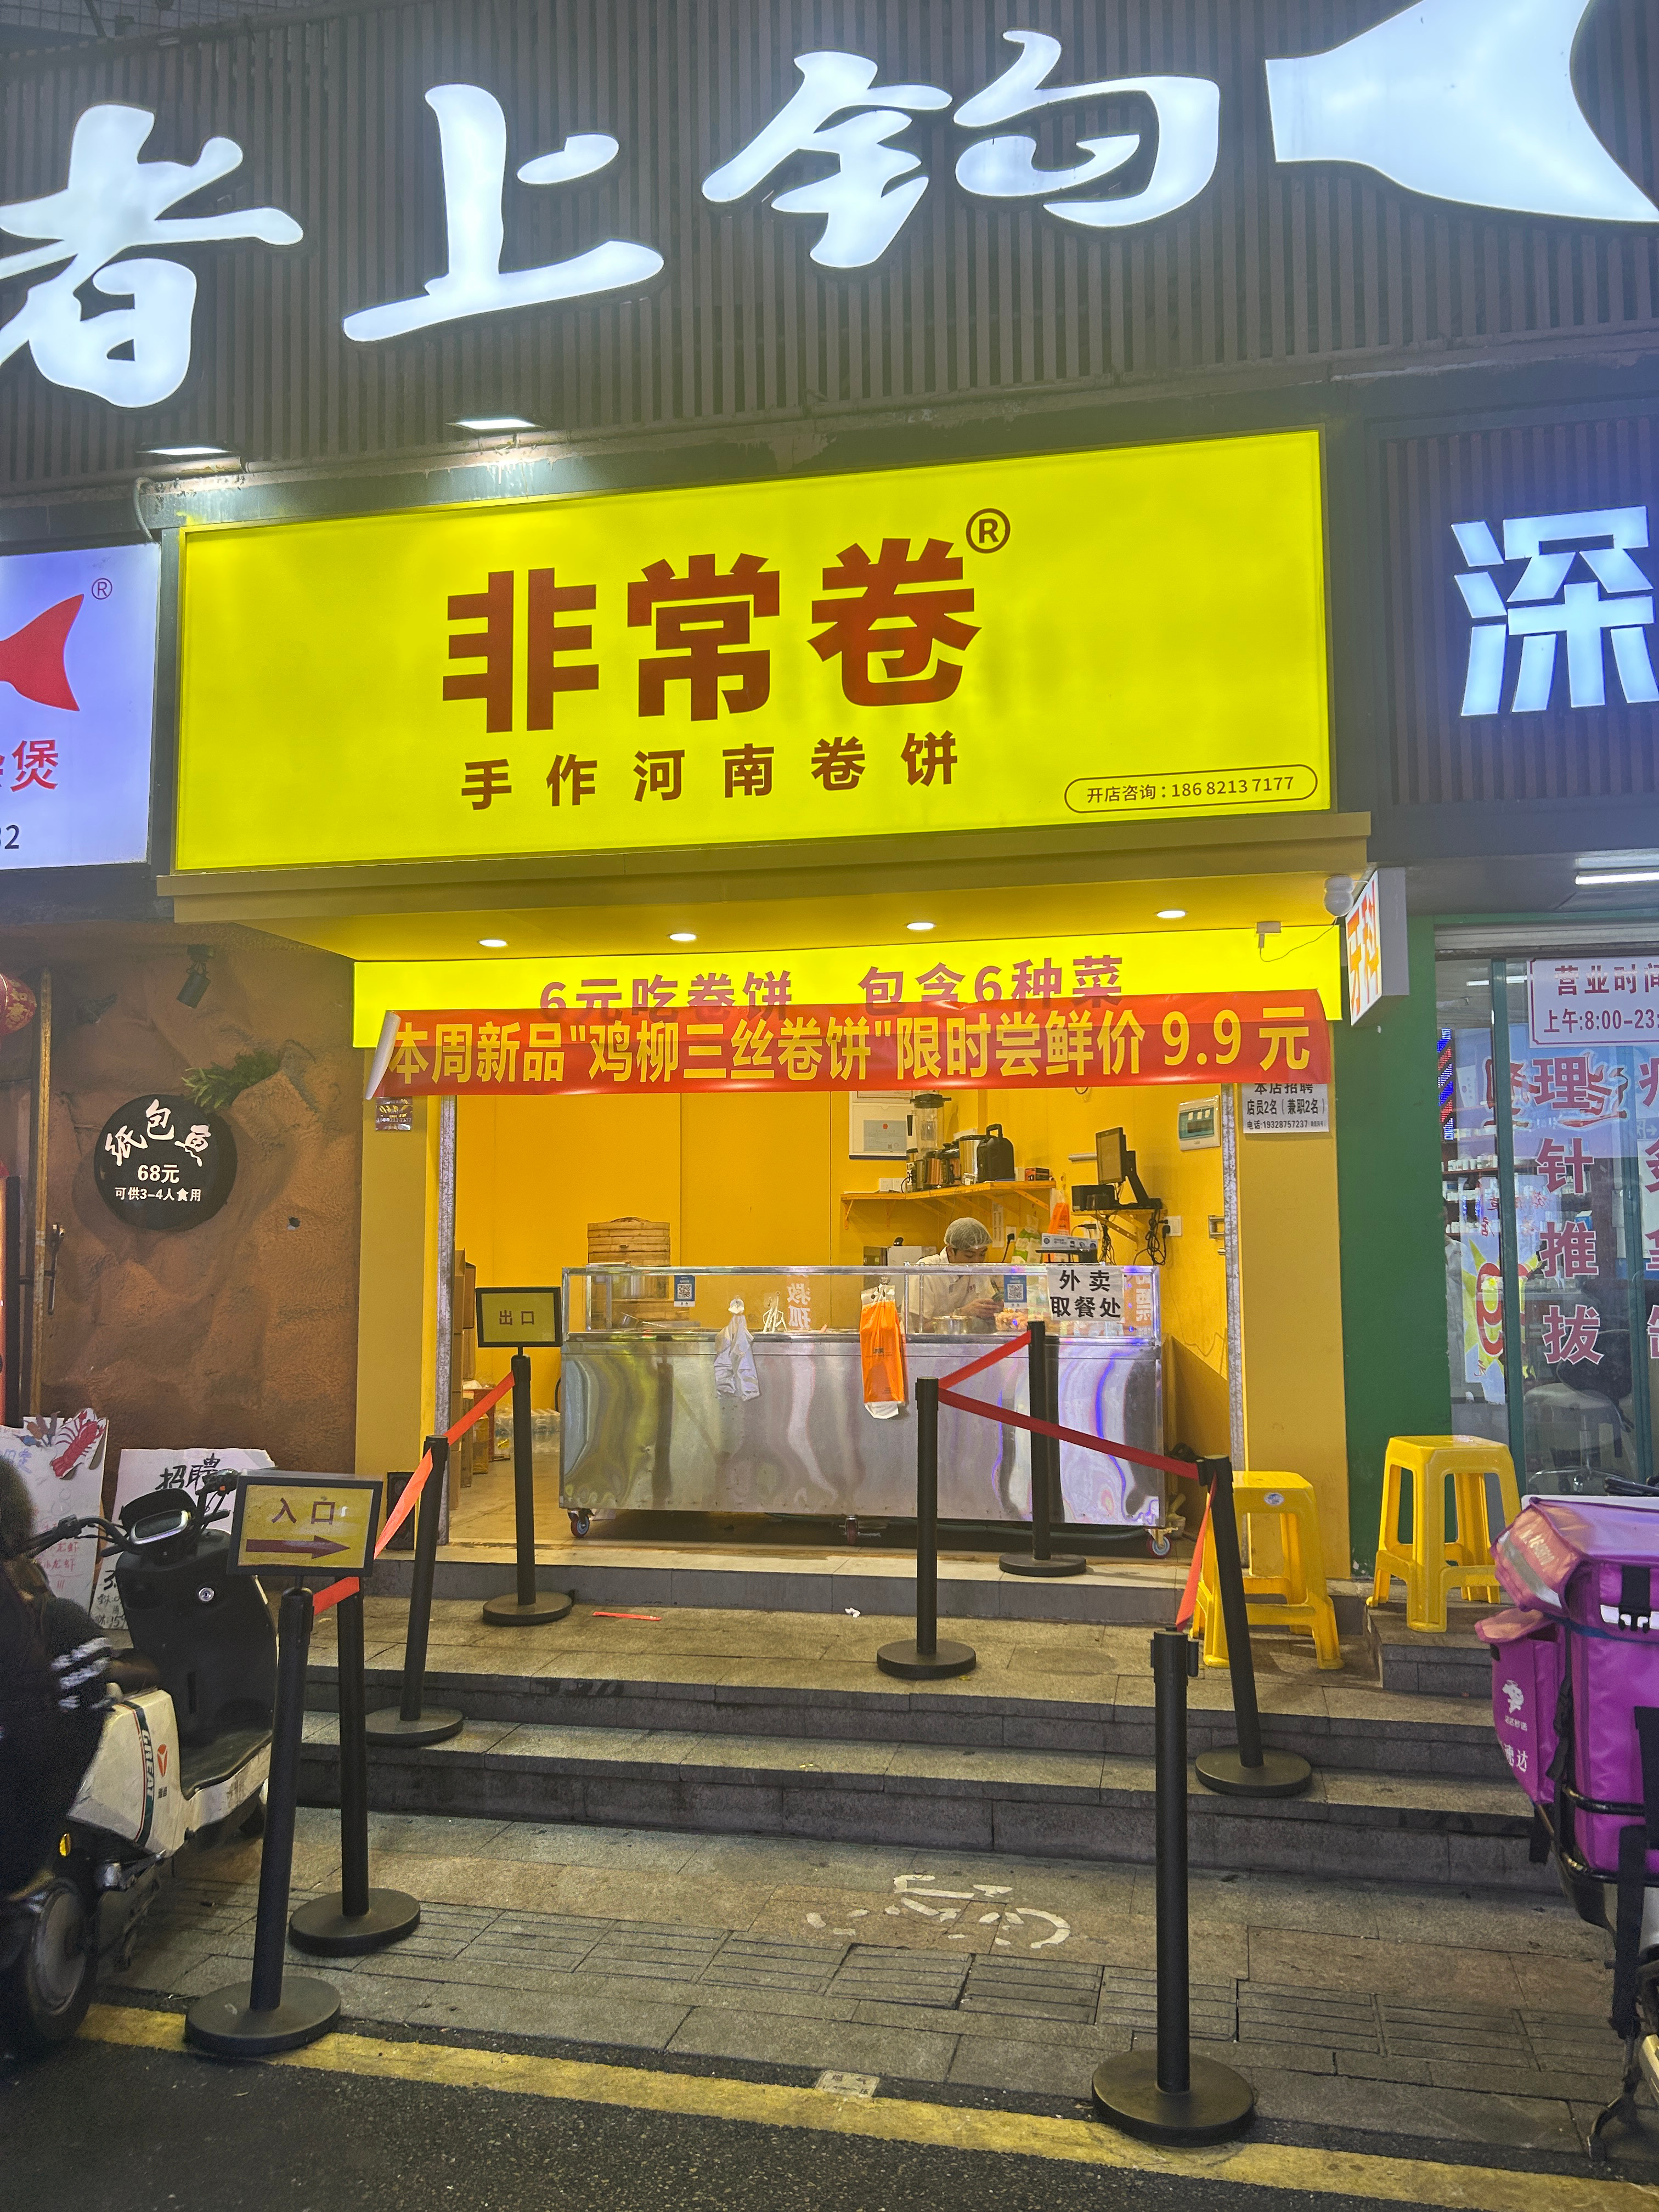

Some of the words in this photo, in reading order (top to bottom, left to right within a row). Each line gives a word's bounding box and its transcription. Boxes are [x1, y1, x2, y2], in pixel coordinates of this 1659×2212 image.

[1451, 506, 1659, 716] 深
[442, 538, 982, 733] 非常卷
[0, 739, 59, 792] 煲
[461, 730, 958, 811] 手作河南卷饼
[0, 825, 20, 850] 2
[540, 970, 792, 1022] 6元吃卷饼
[858, 955, 1124, 1016] 包含6种菜
[1555, 963, 1659, 996] 营业时间
[137, 1164, 180, 1184] 68元
[114, 1187, 202, 1203] 可供3-4人食用
[1059, 1269, 1111, 1291] 外卖
[499, 1309, 535, 1327] 出口
[1050, 1296, 1121, 1319] 取餐处
[272, 1498, 335, 1525] 入口
